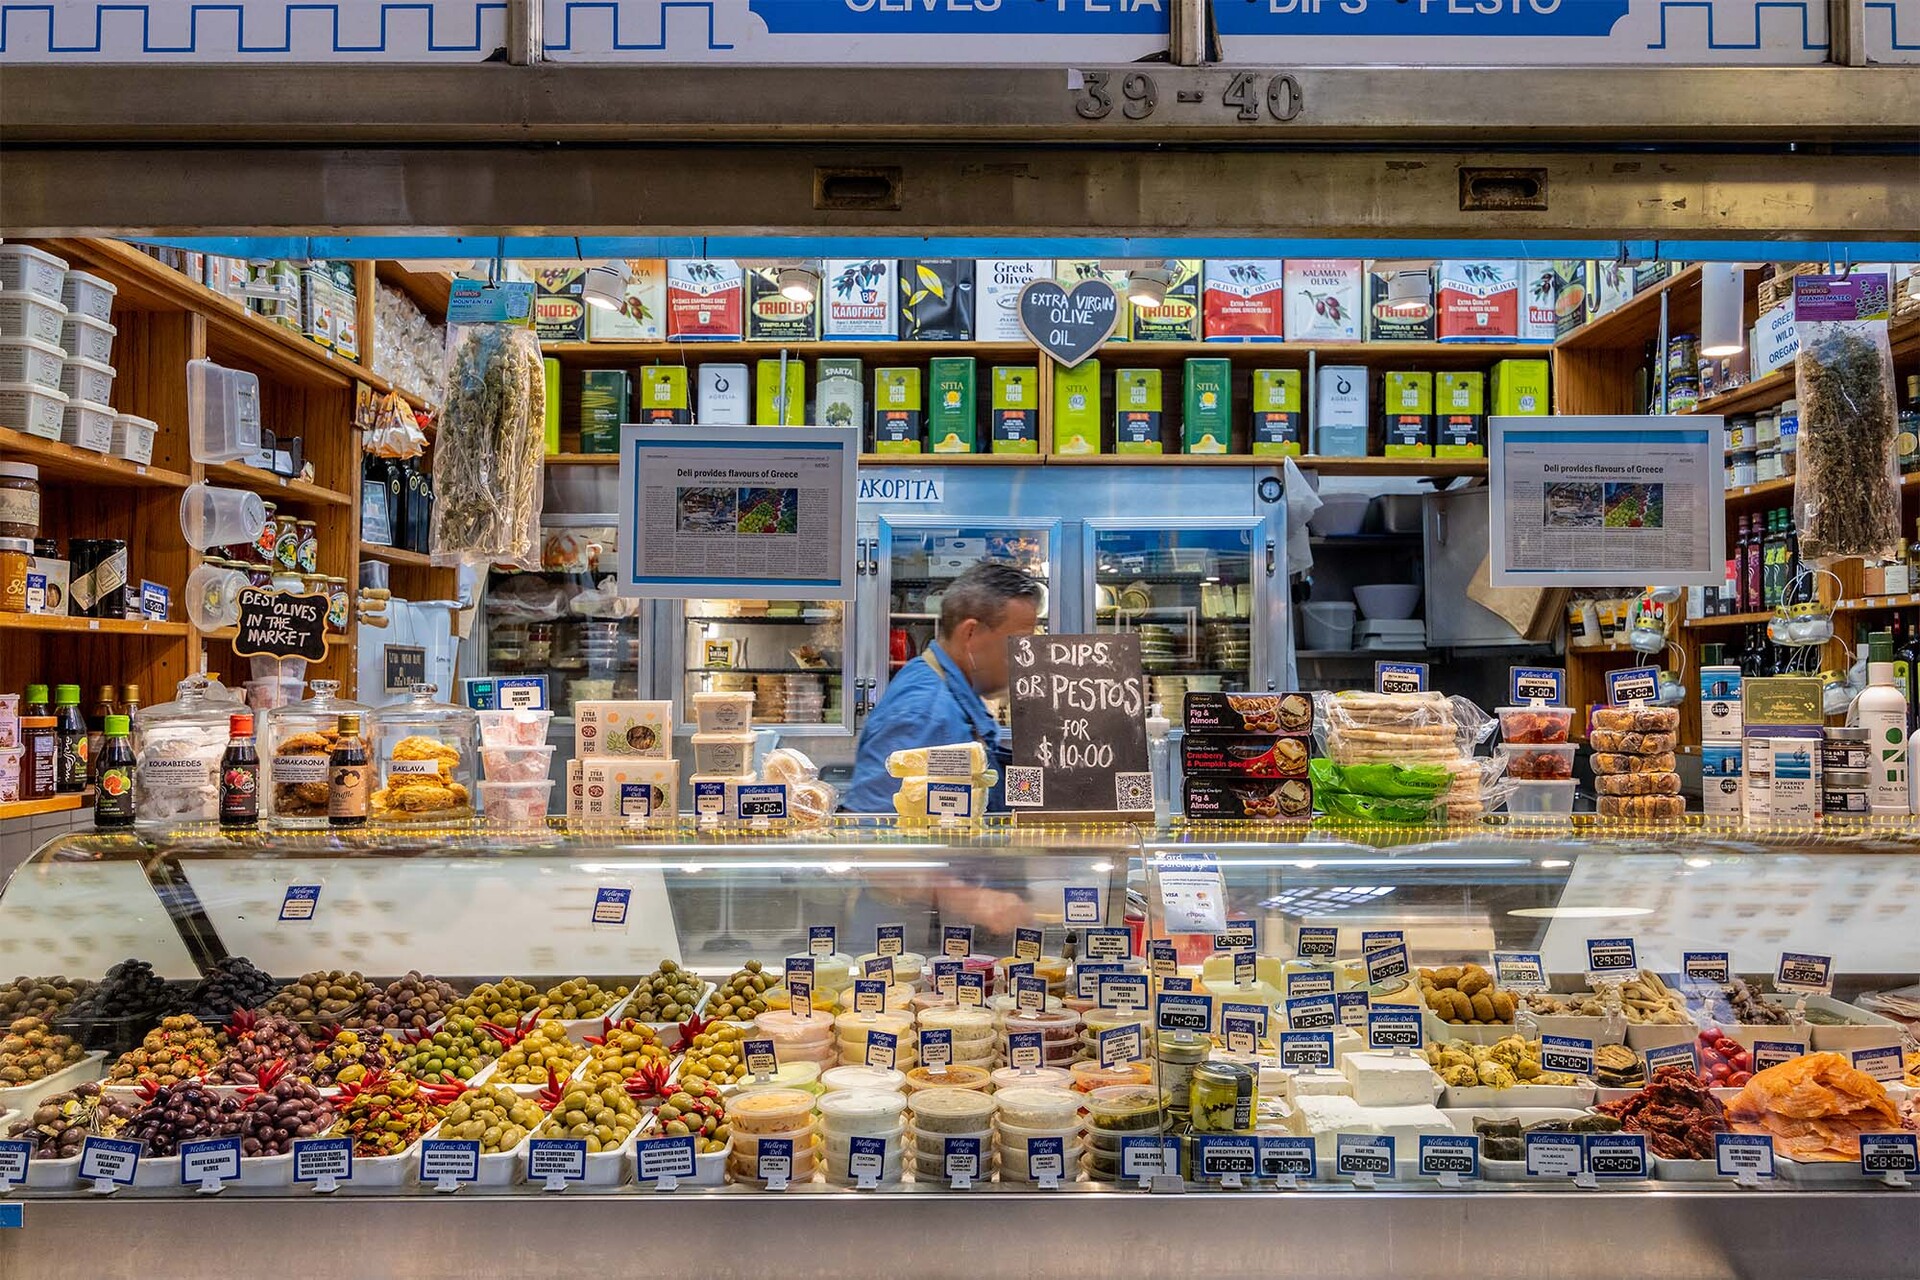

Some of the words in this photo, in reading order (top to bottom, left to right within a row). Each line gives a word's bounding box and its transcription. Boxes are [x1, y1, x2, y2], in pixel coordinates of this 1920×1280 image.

[994, 261, 1034, 273] Greek
[1302, 270, 1347, 278] KALAMATA
[672, 280, 696, 291] OLIVIA
[713, 280, 738, 290] OLIVIA
[1212, 281, 1239, 293] OLIVIA
[1254, 281, 1281, 292] OLIVIA
[1311, 278, 1339, 286] OLIVES
[1448, 281, 1473, 293] OLIVIA
[1490, 281, 1516, 292] OLIVIA
[758, 301, 808, 315] TRIOLEX
[1031, 293, 1068, 309] EXTRA
[1076, 295, 1115, 312] VIRGIN
[1050, 309, 1094, 325] OLIVE
[1049, 329, 1075, 346] OIL
[1776, 327, 1794, 343] WILD
[1769, 340, 1799, 363] OREGAN
[825, 367, 853, 377] SPARTA
[1196, 383, 1219, 391] SITIA
[1515, 386, 1538, 394] SITIA
[677, 468, 693, 477] Deli
[694, 468, 727, 479] provides
[728, 468, 759, 478] flavours
[761, 469, 770, 478] of
[770, 470, 798, 479] Greece
[1544, 464, 1559, 473] Deli
[1560, 464, 1593, 474] provides
[1594, 464, 1625, 473] flavours
[1627, 465, 1635, 473] of
[1636, 465, 1664, 474] Greece
[858, 478, 939, 501] AKOPITA
[242, 591, 276, 607] BEST
[274, 601, 317, 622] OLIVES
[247, 614, 263, 626] IN
[265, 616, 293, 631] THE
[248, 629, 310, 647] MARKET
[1014, 639, 1035, 667] 3
[1050, 643, 1109, 667] DIPS
[1016, 675, 1045, 698] OR
[1052, 674, 1142, 716] PESTOS
[1190, 709, 1202, 717] Fig
[1062, 718, 1090, 741] FOR
[1190, 794, 1202, 802] Fig
[855, 1140, 881, 1148] Hellenic
[1033, 1140, 1058, 1148] Hellenic
[1207, 1138, 1235, 1147] Hellenic
[1236, 1139, 1250, 1147] Deli
[1263, 1140, 1291, 1148] Hellenic
[1292, 1140, 1306, 1148] Deli
[1531, 1136, 1559, 1144] Hellenic
[1866, 1136, 1892, 1144] Hellenic
[92, 1140, 117, 1151] Hellenic
[119, 1144, 133, 1153] Deli
[189, 1143, 215, 1153] Hellenic
[216, 1141, 232, 1150] Deli
[97, 1161, 120, 1169] KALAMATA
